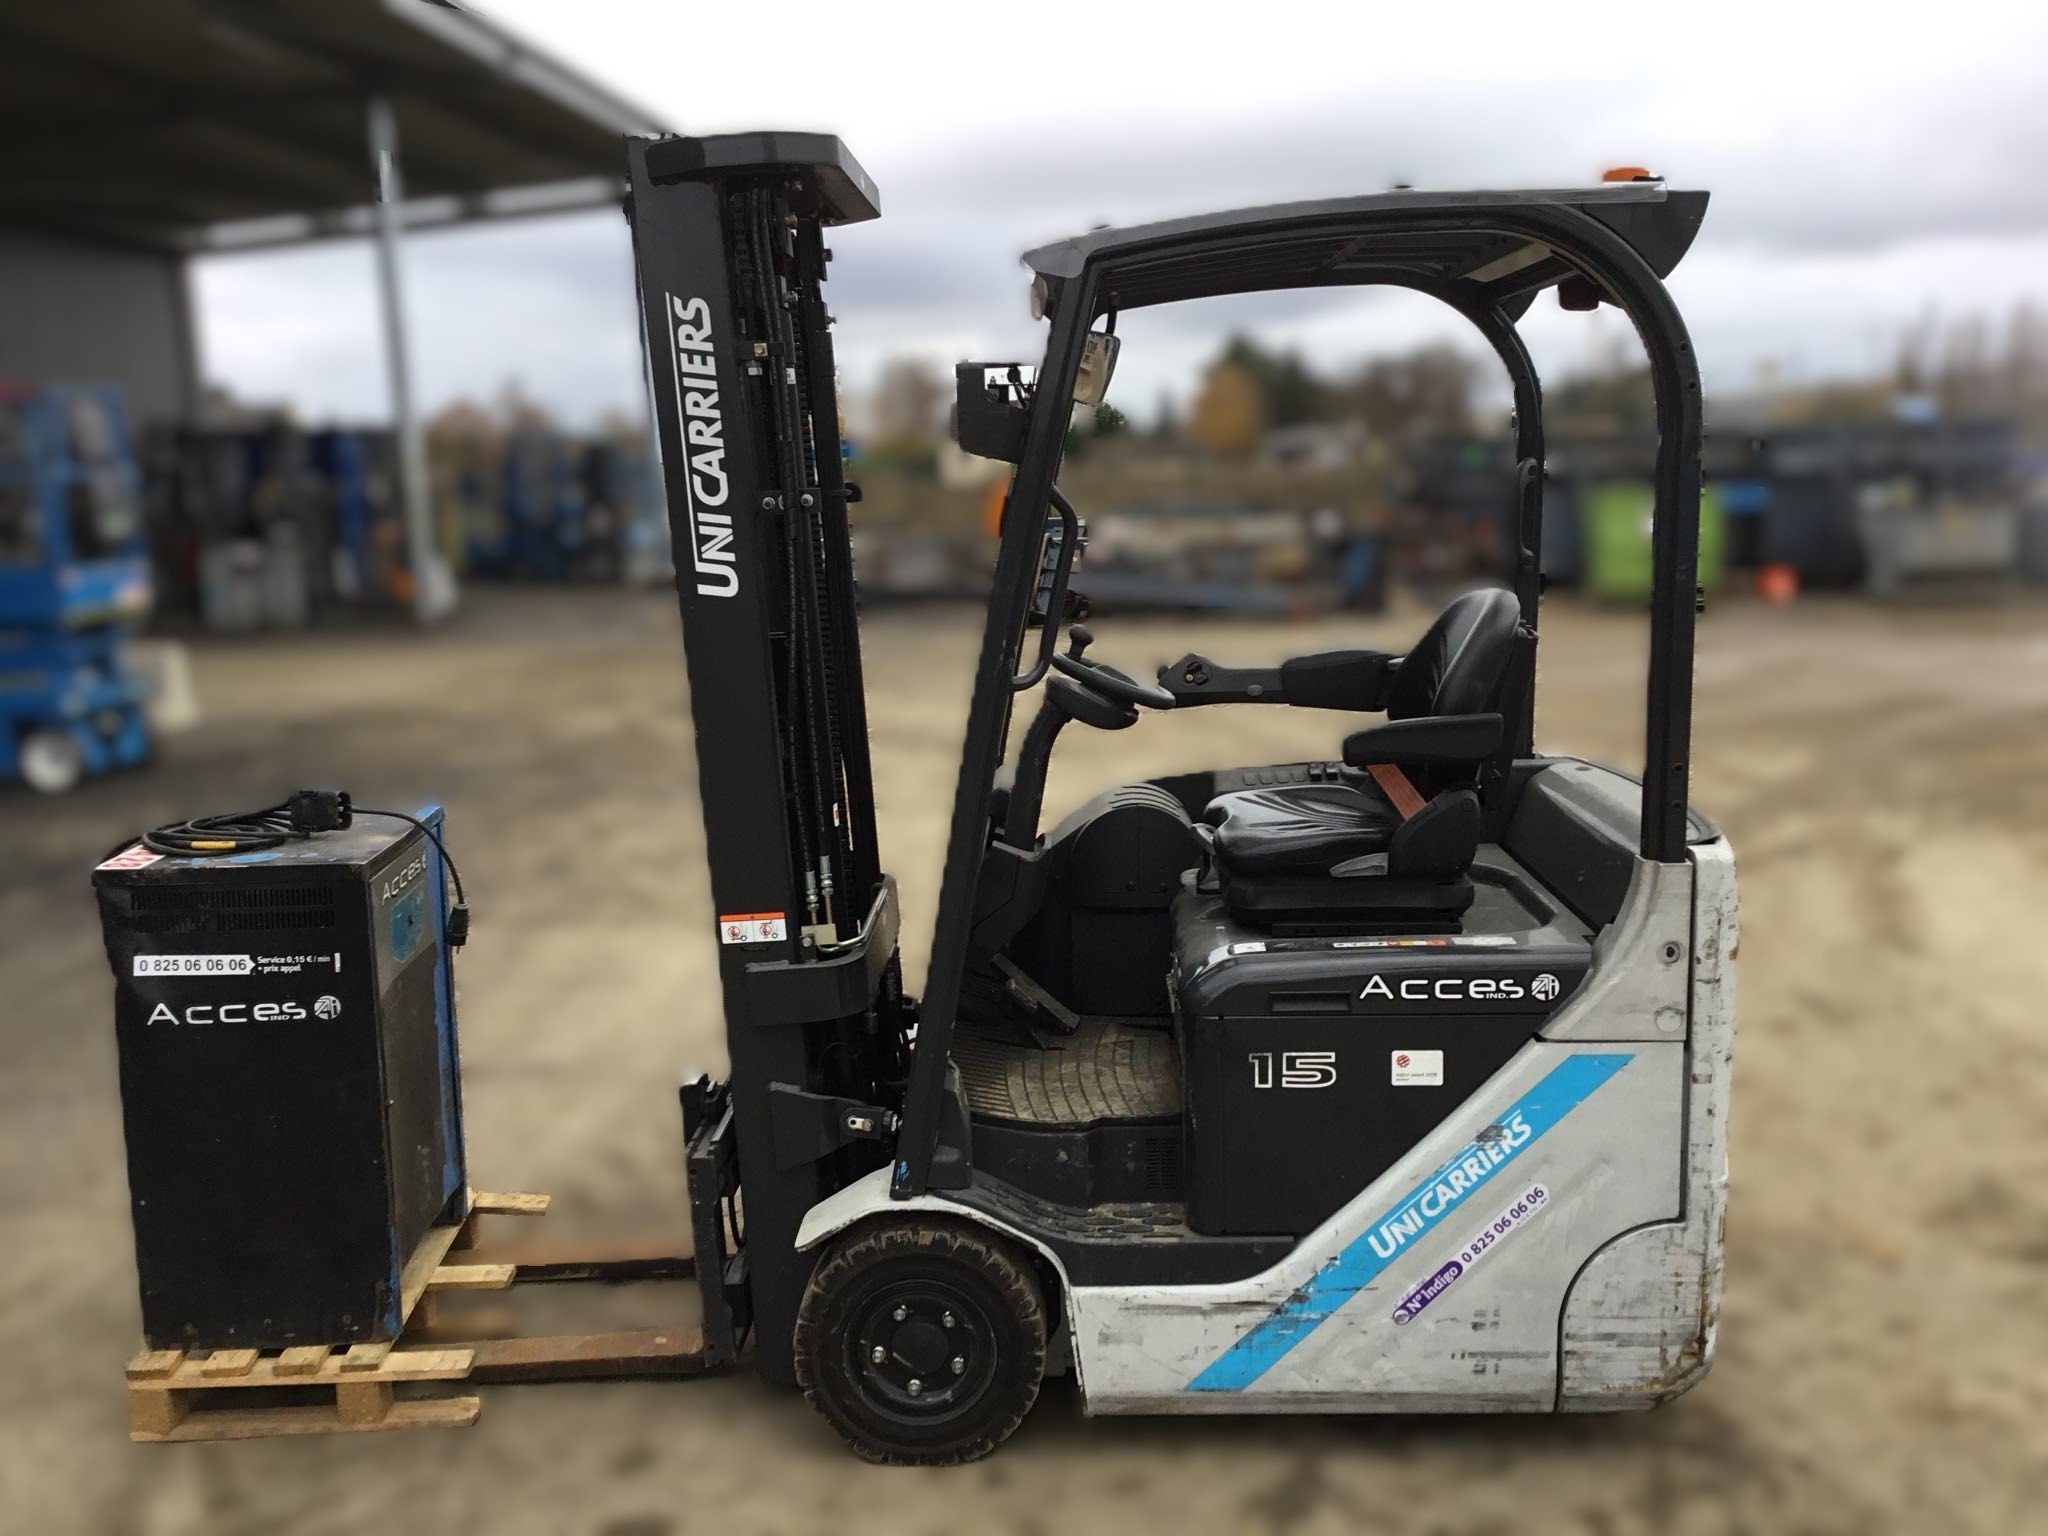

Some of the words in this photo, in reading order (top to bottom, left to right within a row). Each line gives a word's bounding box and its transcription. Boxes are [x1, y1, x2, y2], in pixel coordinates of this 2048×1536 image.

[139, 959, 148, 971] 0
[153, 959, 180, 971] 825
[184, 959, 201, 971] 06
[206, 959, 224, 971] 06
[229, 958, 247, 970] 06
[263, 965, 279, 974] prix
[280, 963, 301, 974] appel
[286, 955, 305, 963] 0,15
[306, 955, 313, 963] €
[1359, 975, 1524, 999] Acces
[147, 1002, 307, 1026] Acces
[1249, 1052, 1337, 1089] 15
[1461, 1252, 1472, 1263] 0
[1470, 1231, 1496, 1255] 825
[1493, 1216, 1512, 1234] 06
[1509, 1201, 1528, 1220] 06
[1525, 1186, 1545, 1205] 06
